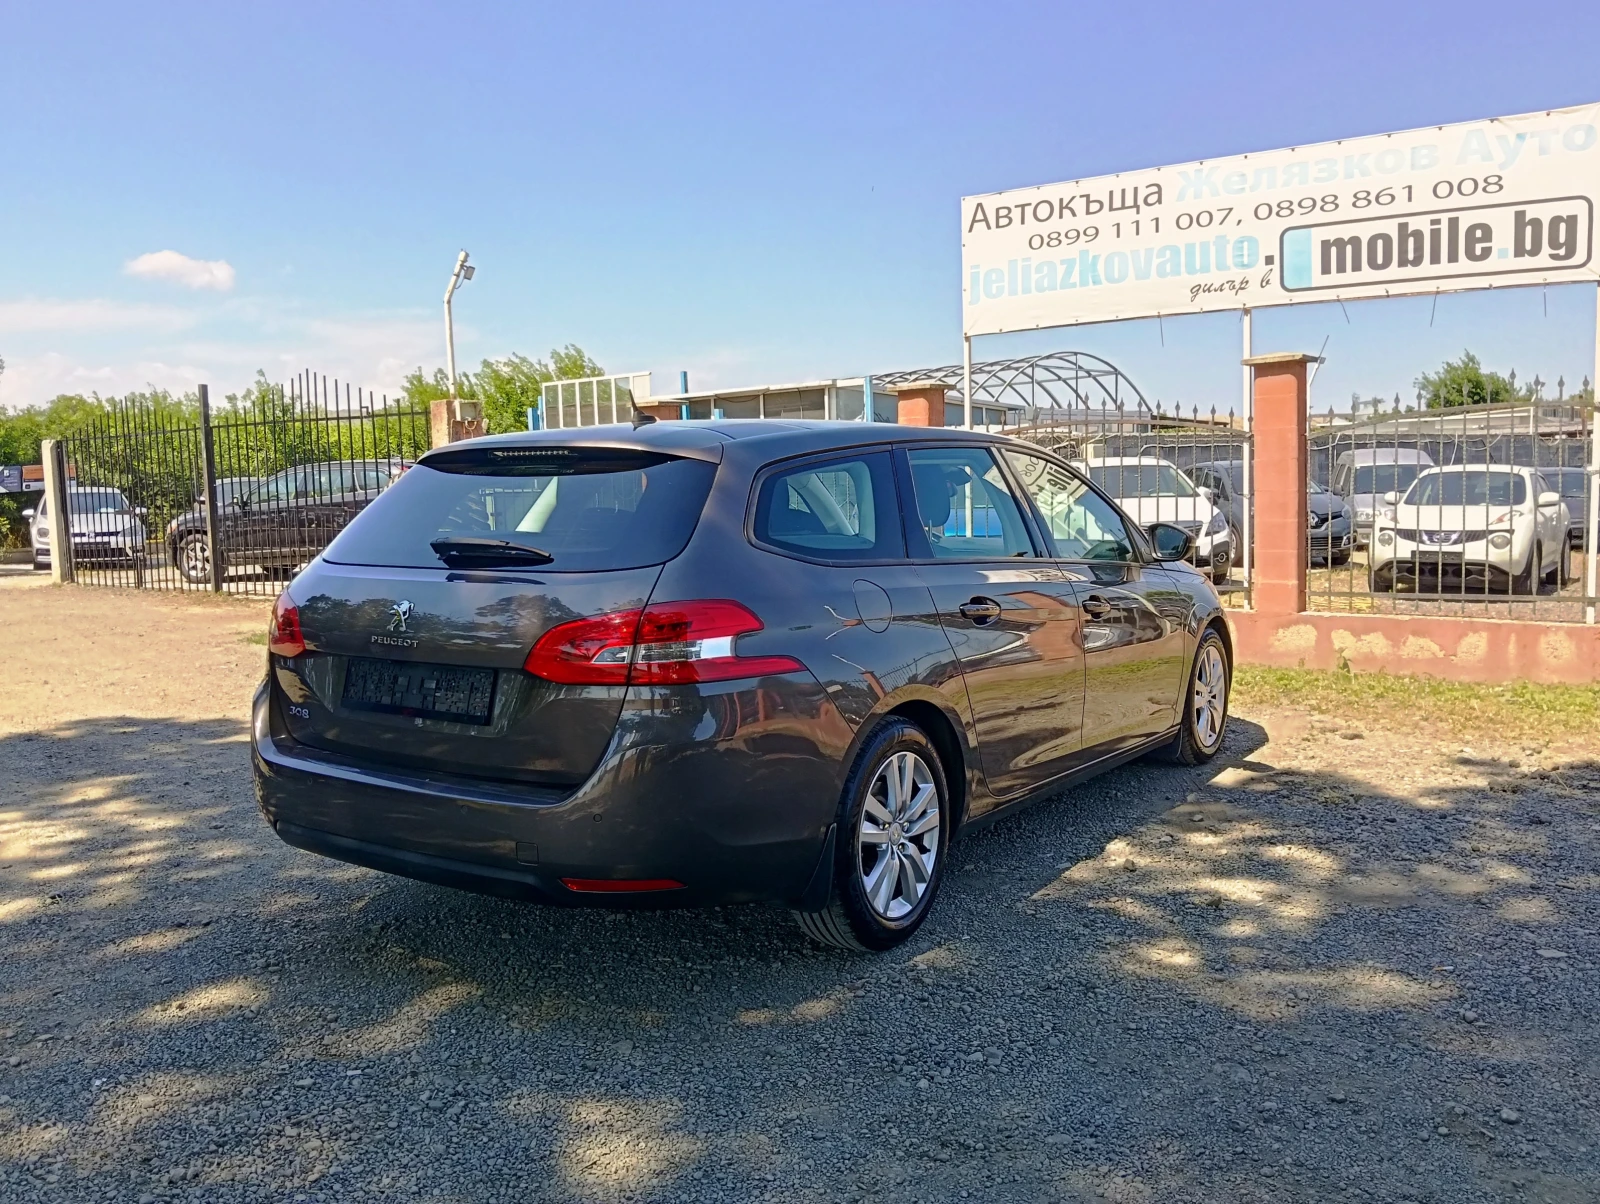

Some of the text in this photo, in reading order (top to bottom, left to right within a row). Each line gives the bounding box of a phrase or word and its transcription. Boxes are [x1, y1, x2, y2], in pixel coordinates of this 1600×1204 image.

[967, 123, 1598, 234] Автокъща Желязков Ауто
[1028, 174, 1505, 250] 0899 111 007, 0898 861 008
[1319, 209, 1579, 277] mobile.bg
[1189, 275, 1251, 302] дилър
[371, 635, 419, 648] PEUGEOT
[289, 705, 310, 719] 308
